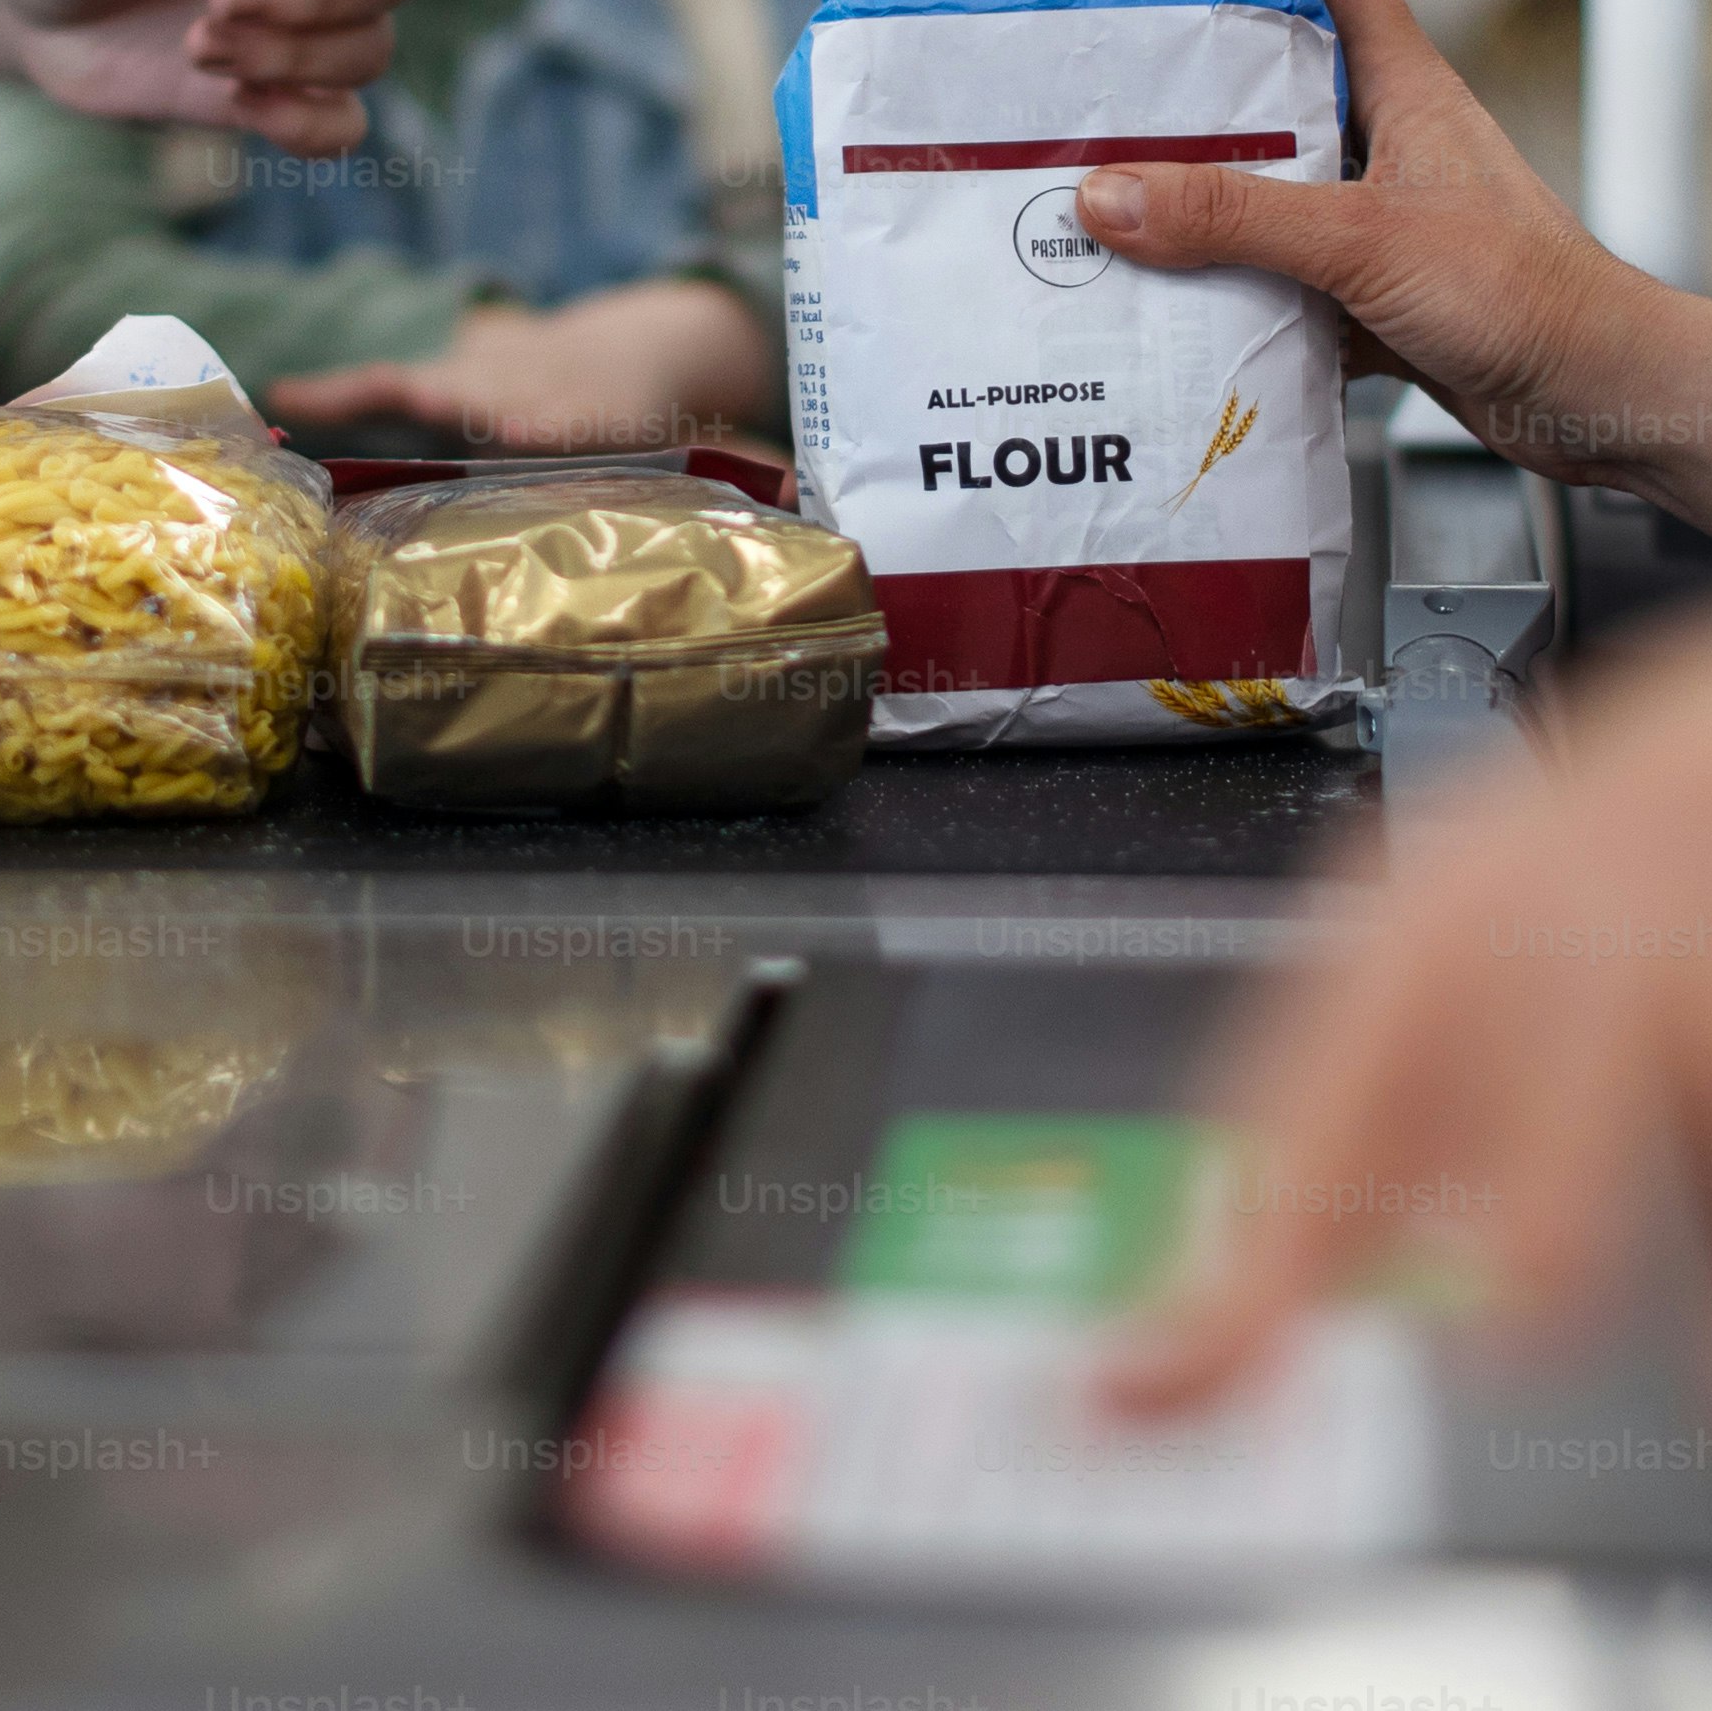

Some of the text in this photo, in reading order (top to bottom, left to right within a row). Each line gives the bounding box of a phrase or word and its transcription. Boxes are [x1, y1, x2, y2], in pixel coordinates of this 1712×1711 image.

[809, 292, 821, 304] kJ
[802, 309, 822, 323] kcal
[800, 328, 824, 344] 1,3 g
[819, 365, 826, 379] g
[820, 383, 827, 396] g
[927, 381, 1105, 409] ALL-PURPOSE
[820, 401, 829, 414] g
[821, 419, 830, 432] g
[821, 436, 831, 450] g
[919, 434, 1133, 491] FLOUR
